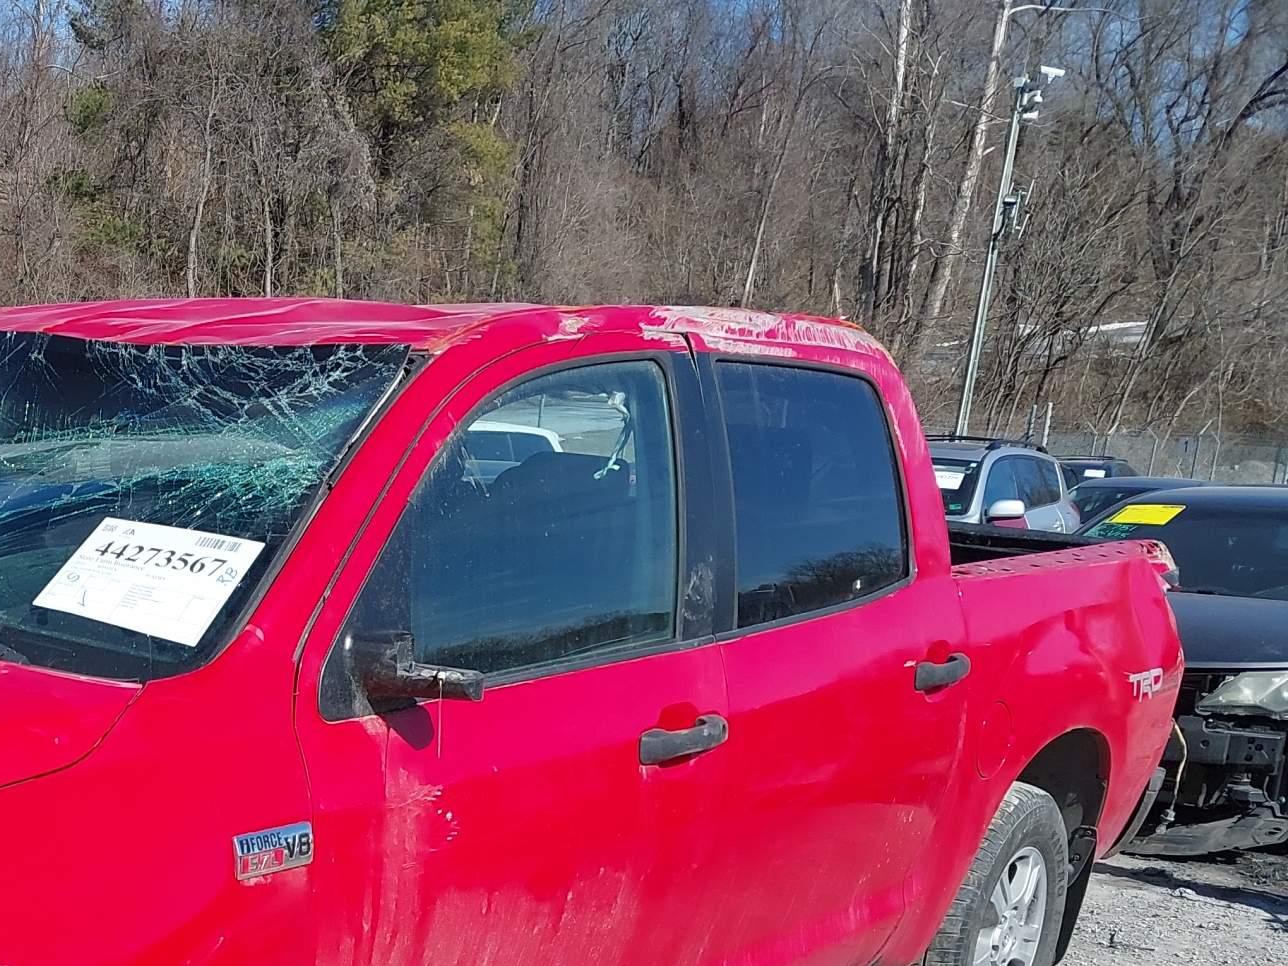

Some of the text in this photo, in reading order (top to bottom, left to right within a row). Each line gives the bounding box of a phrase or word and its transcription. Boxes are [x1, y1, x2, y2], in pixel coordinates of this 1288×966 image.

[95, 541, 227, 576] 44273567
[1129, 668, 1163, 700] TRD
[284, 832, 312, 859] V8
